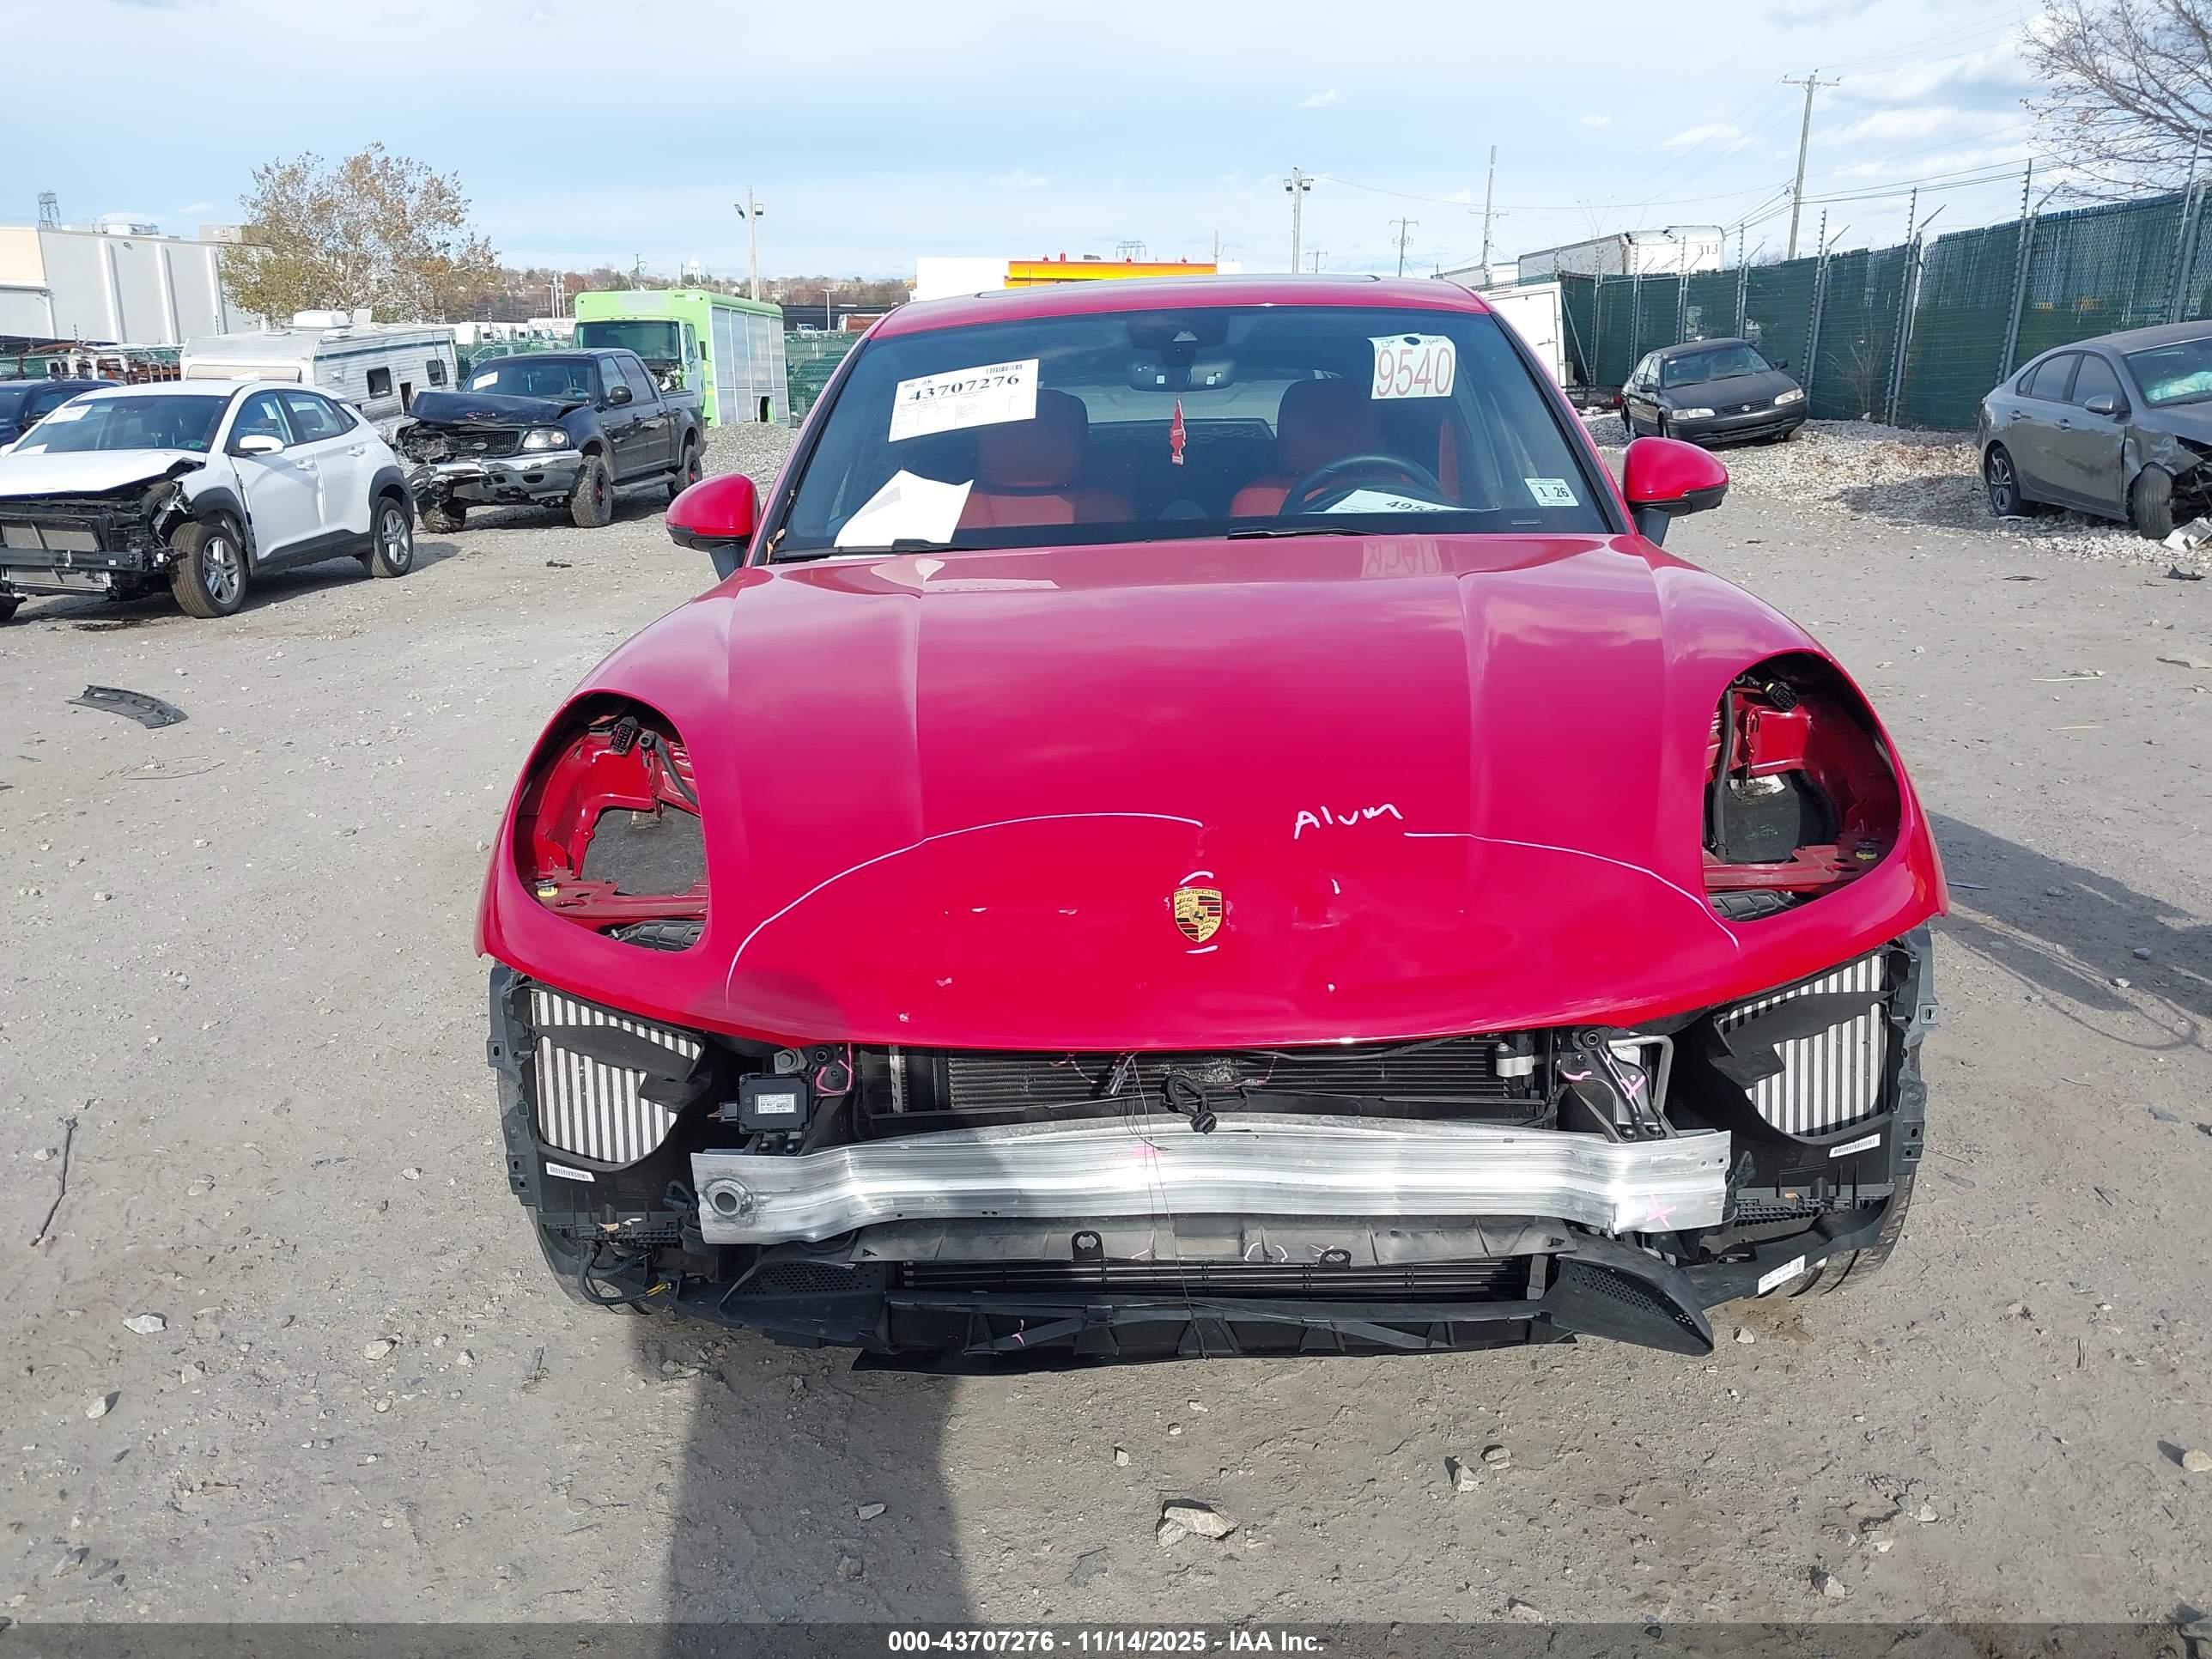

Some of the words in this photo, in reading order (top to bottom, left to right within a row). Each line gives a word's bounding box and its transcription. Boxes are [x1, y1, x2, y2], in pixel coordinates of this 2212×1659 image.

[1376, 347, 1453, 397] 9540
[908, 374, 1020, 401] 43707276
[1538, 487, 1549, 497] 1
[1553, 487, 1570, 497] 26
[1175, 890, 1220, 898] PORSCHE
